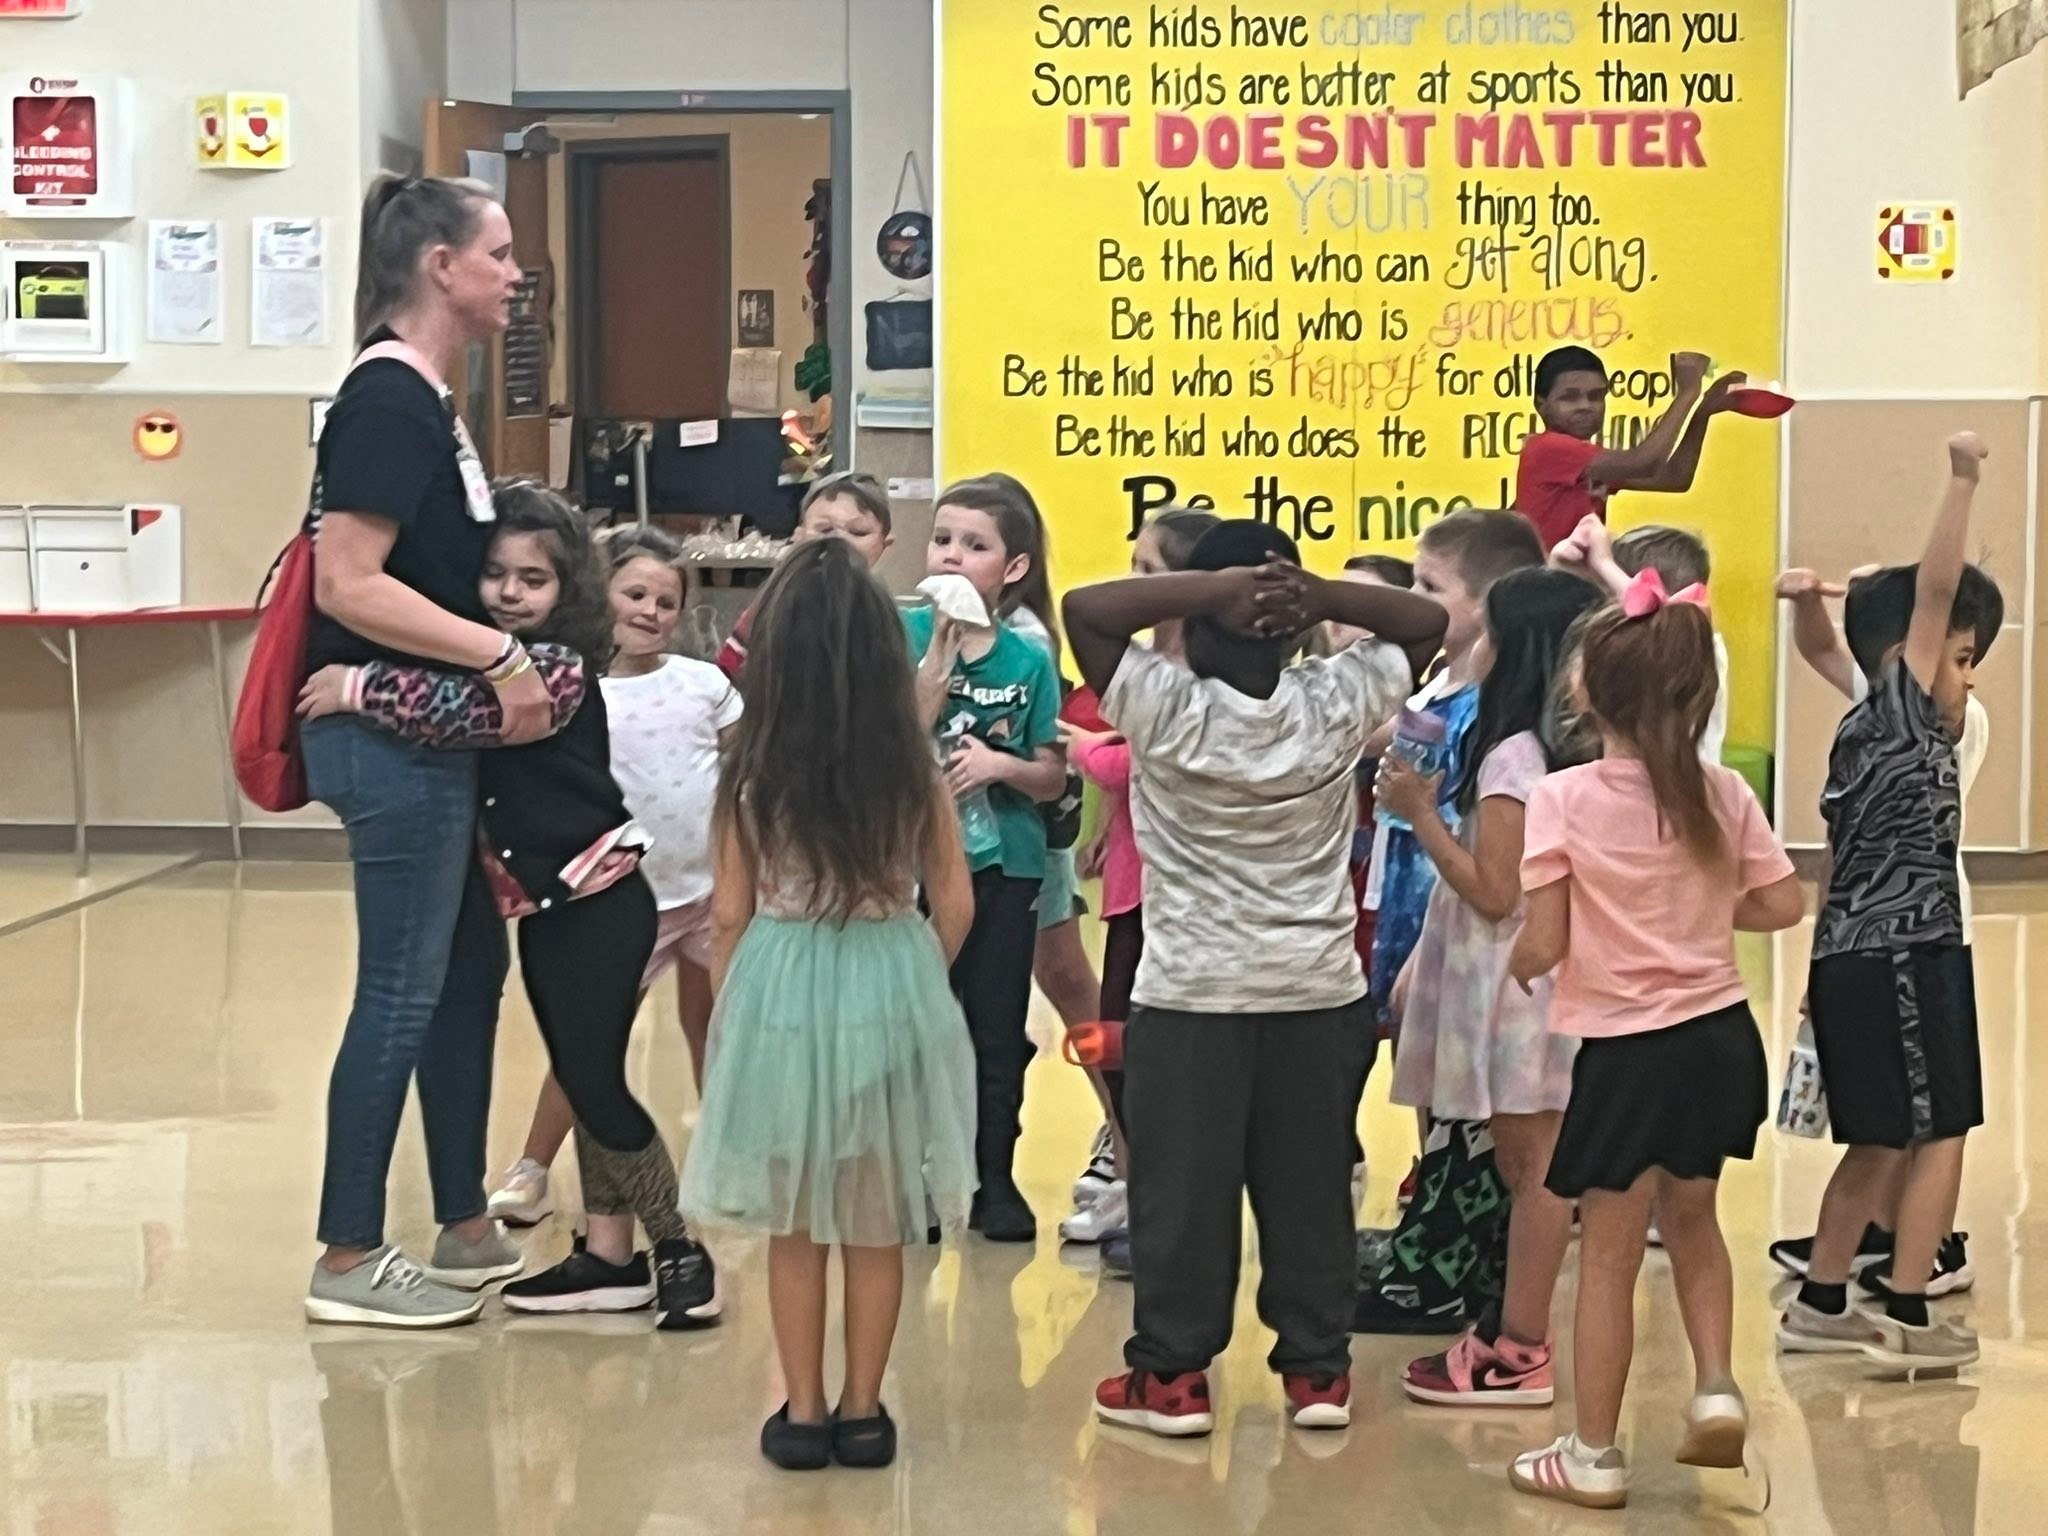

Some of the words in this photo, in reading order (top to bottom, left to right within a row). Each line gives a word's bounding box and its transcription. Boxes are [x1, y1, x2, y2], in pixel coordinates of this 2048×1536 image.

[1035, 4, 1132, 48] Some
[1150, 4, 1221, 48] kids
[1231, 4, 1308, 48] have
[1320, 2, 1425, 46] cooler
[1446, 0, 1575, 46] clothes
[1597, 1, 1670, 44] than
[1032, 61, 1131, 106] Some
[1151, 61, 1226, 107] kids
[1239, 73, 1290, 105] are
[1301, 60, 1396, 107] better
[1417, 59, 1451, 105] at
[1467, 60, 1581, 112] sports
[1596, 59, 1667, 103] than
[1067, 113, 1131, 168] IT
[1455, 111, 1707, 169] MATTER
[1137, 180, 1190, 227] You
[1201, 181, 1269, 226] have
[1287, 173, 1429, 235] YOUR
[1456, 180, 1536, 237] thing
[1549, 181, 1600, 226] too.
[1099, 238, 1145, 282] Be
[1160, 238, 1217, 282] the
[1229, 238, 1273, 282] kid
[1291, 238, 1363, 283] who
[1376, 253, 1430, 283] can
[1444, 228, 1520, 292] get
[1531, 226, 1658, 292] along.
[1111, 296, 1154, 340] Be
[1170, 296, 1222, 340] the
[1232, 297, 1280, 340] kid
[1298, 297, 1363, 341] who
[1380, 300, 1408, 341] is
[1003, 354, 1047, 396] Be
[1057, 354, 1104, 396] the
[1113, 354, 1153, 396] kid
[1173, 354, 1233, 396] who
[1249, 360, 1274, 397] is
[1436, 352, 1483, 396] for
[1606, 353, 1678, 408] eopl
[1056, 414, 1101, 457] Be
[1107, 414, 1155, 457] the
[1164, 413, 1205, 457] kid
[1222, 415, 1279, 457] who
[1288, 415, 1359, 458] does
[1378, 415, 1426, 458] the
[1463, 411, 1538, 458] RIG
[1244, 475, 1336, 541] the
